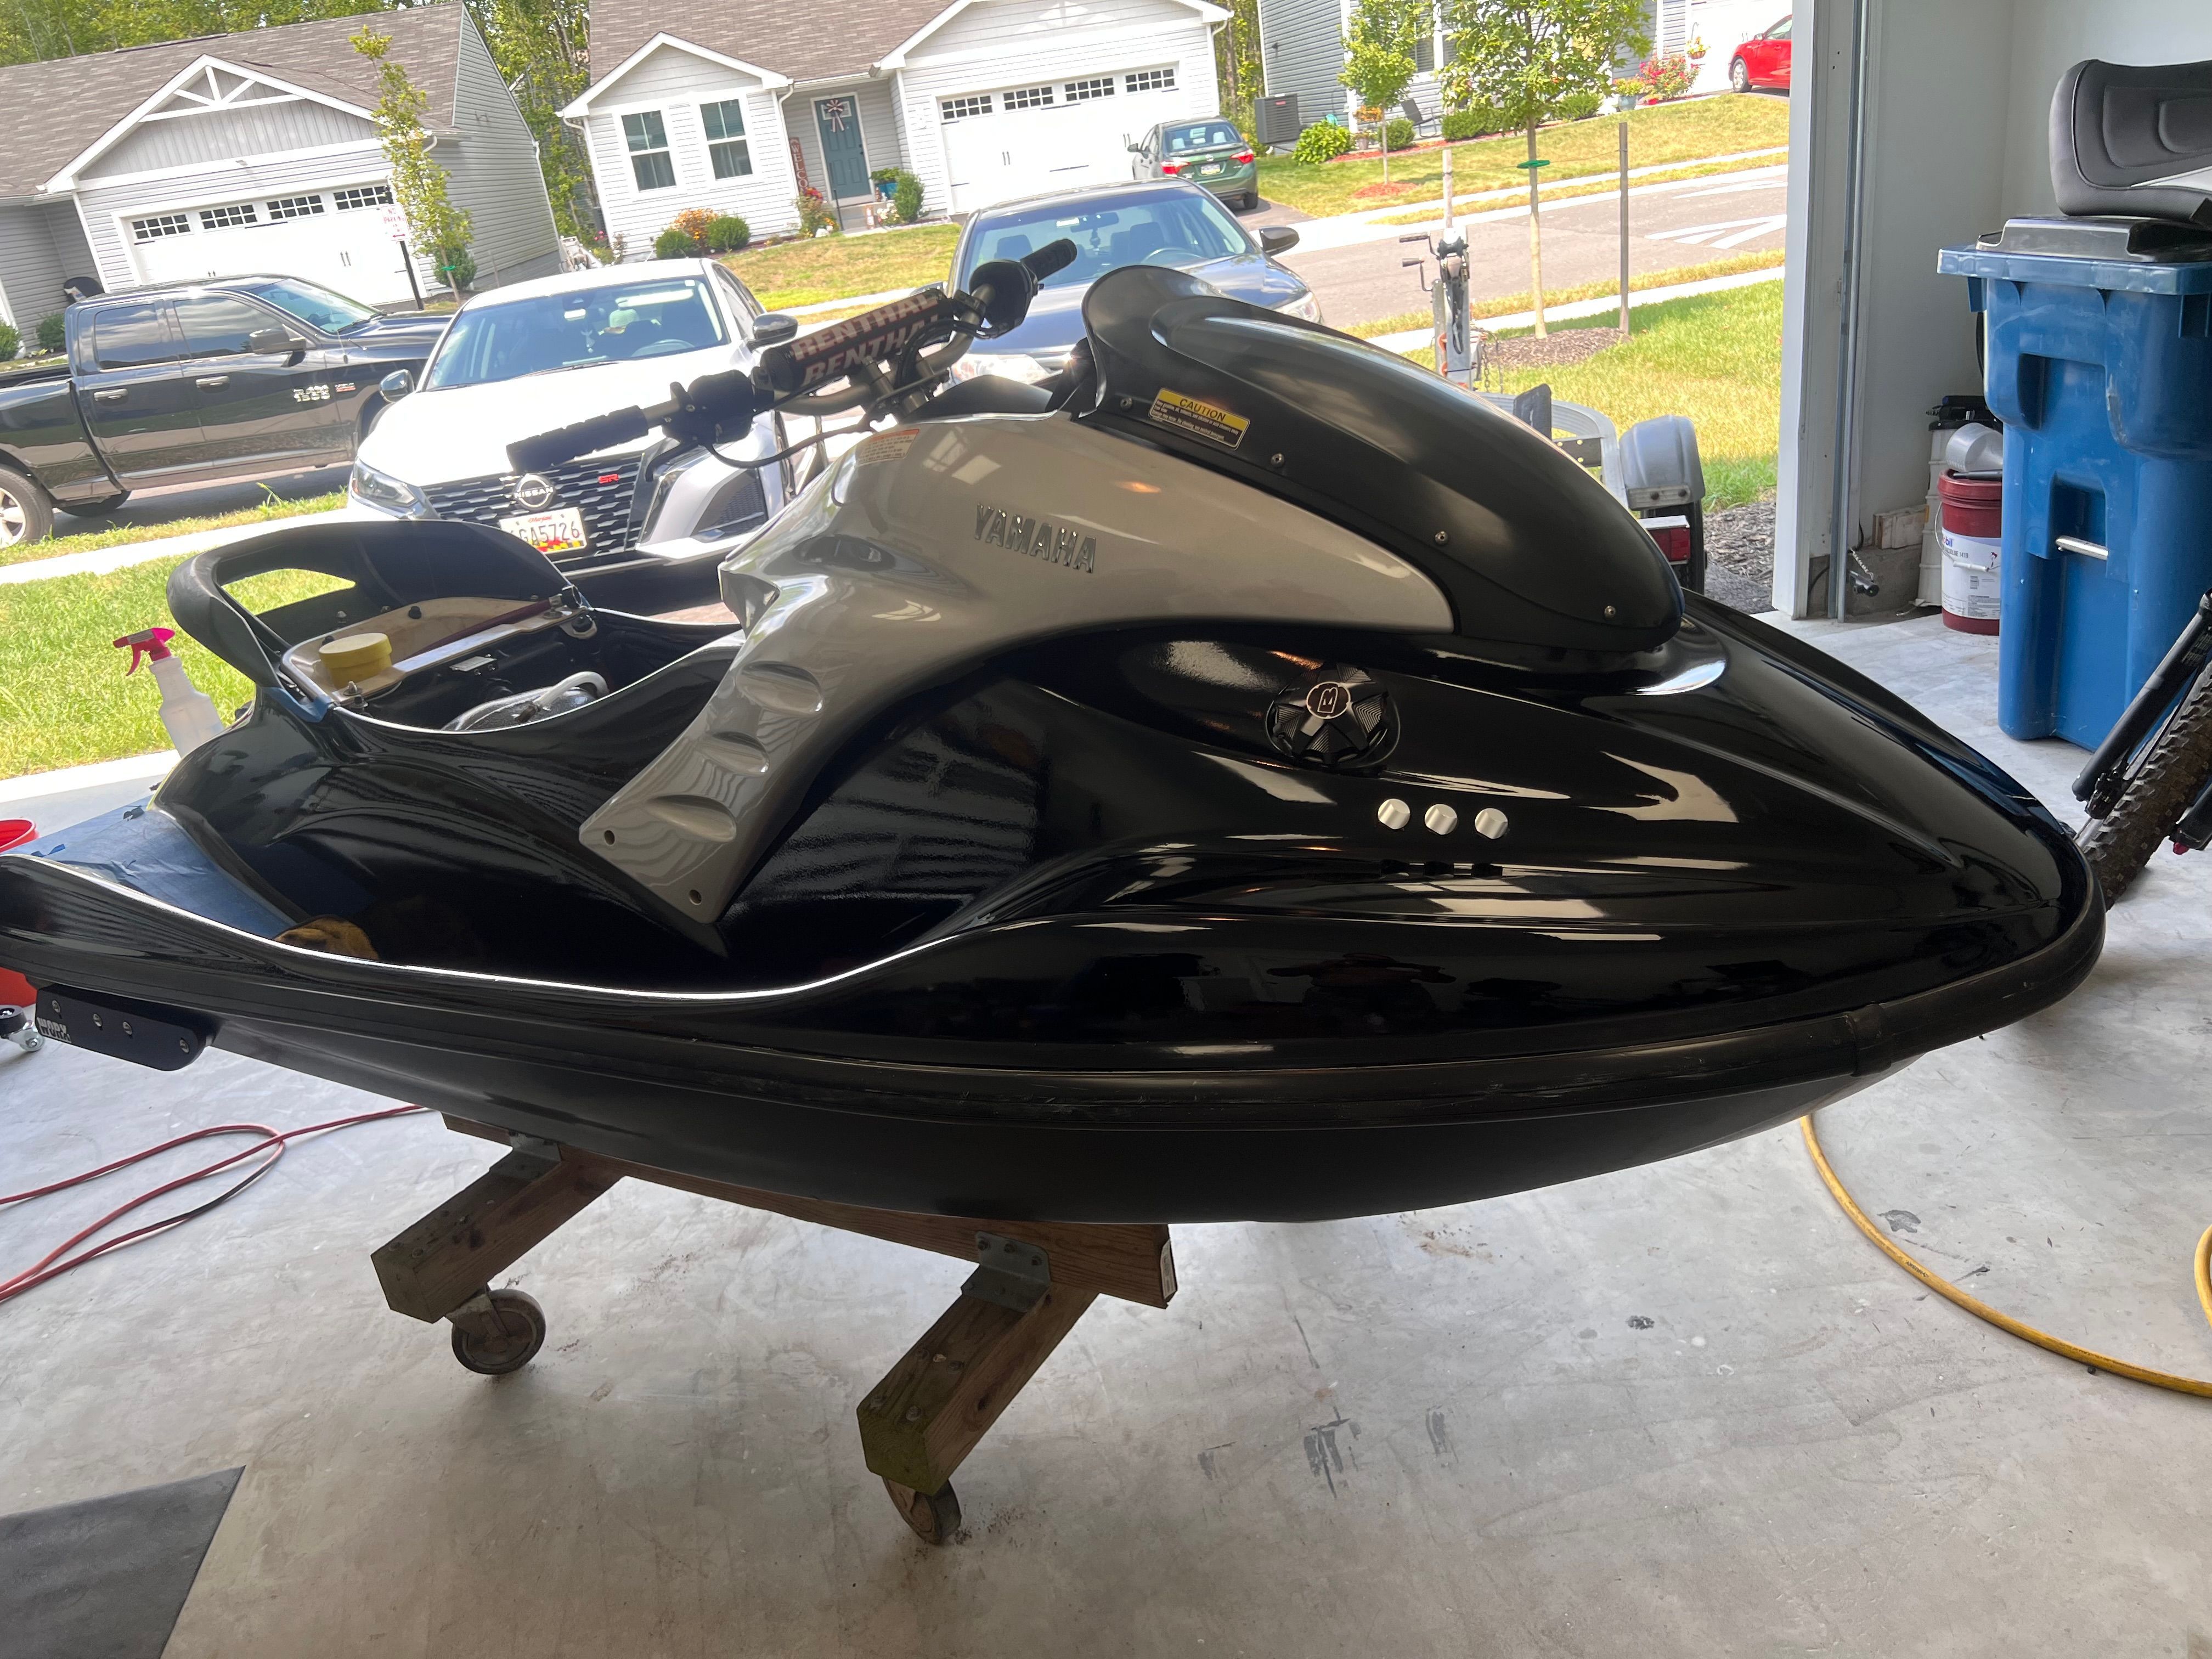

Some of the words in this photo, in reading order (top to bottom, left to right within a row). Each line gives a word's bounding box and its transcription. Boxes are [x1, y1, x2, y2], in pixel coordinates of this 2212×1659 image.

[791, 294, 939, 360] RENTHAL
[1179, 398, 1227, 422] CAUTION
[598, 473, 619, 484] SR
[514, 487, 554, 499] NISSAN
[974, 503, 1097, 574] YAMAHA
